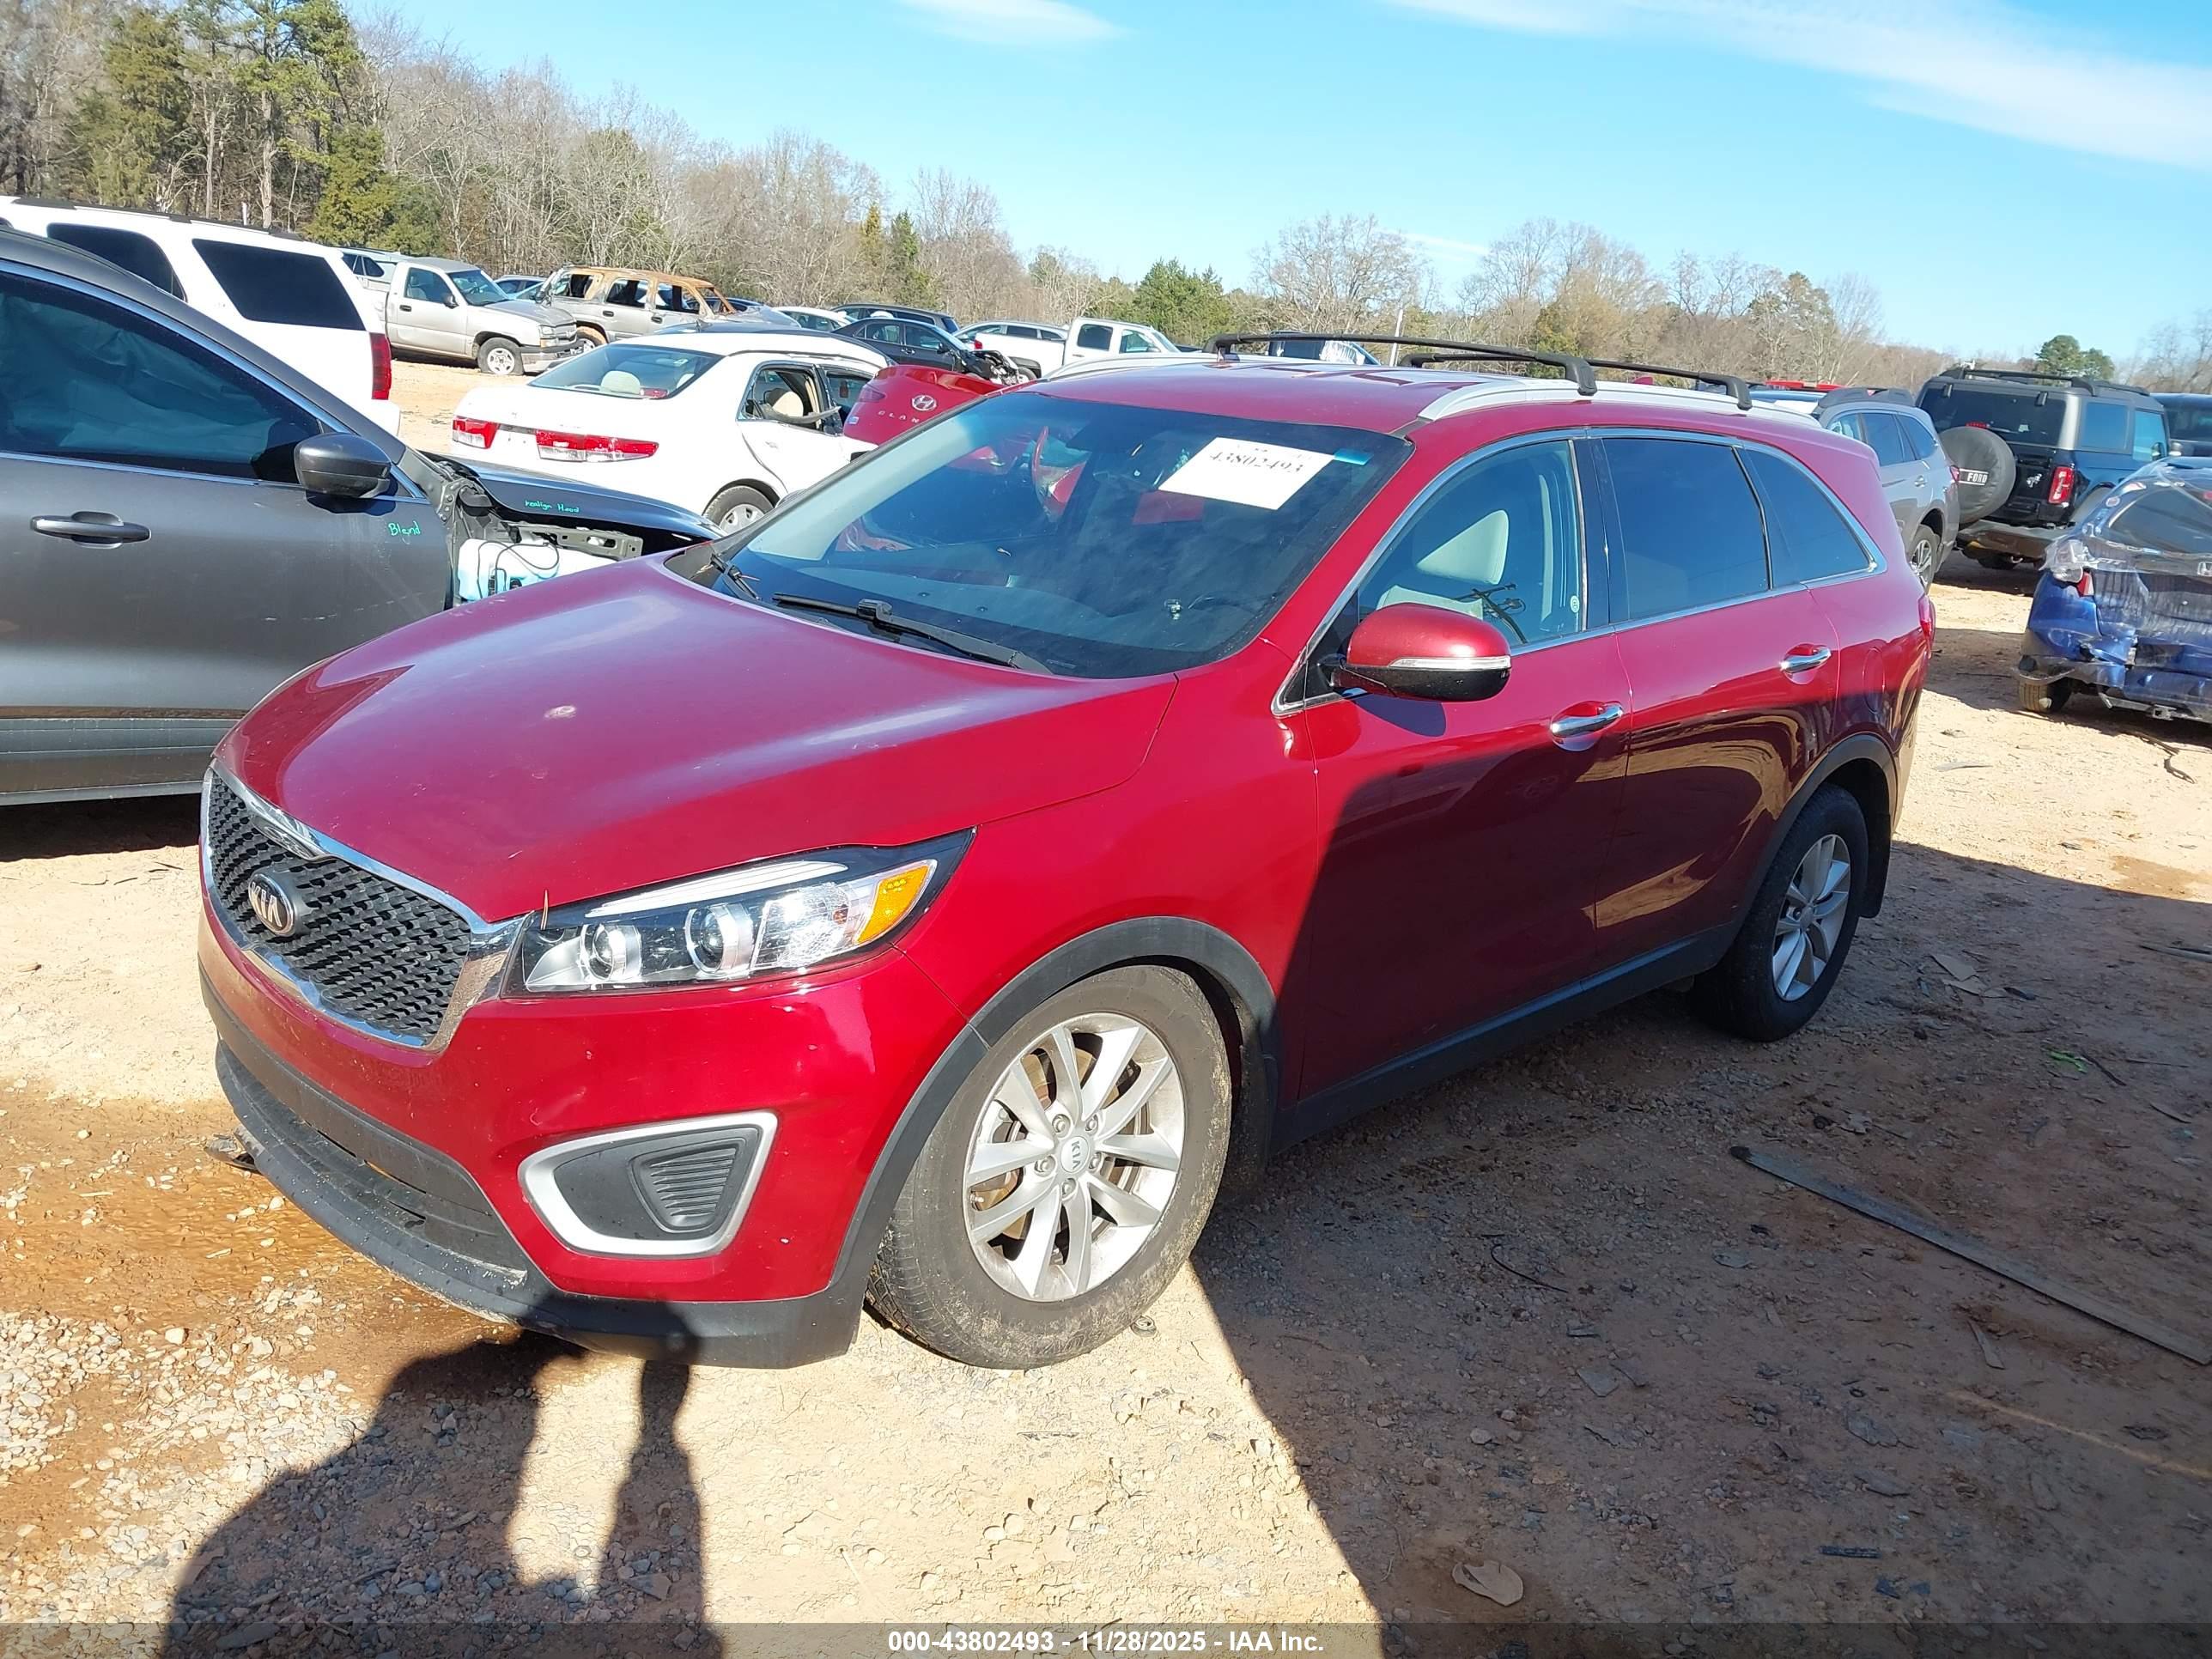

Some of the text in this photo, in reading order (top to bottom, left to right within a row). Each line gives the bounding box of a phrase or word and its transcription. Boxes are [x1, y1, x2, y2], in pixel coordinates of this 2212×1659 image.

[1966, 471, 1988, 483] FORD
[388, 520, 421, 536] Blend
[1071, 1140, 1081, 1170] KIA
